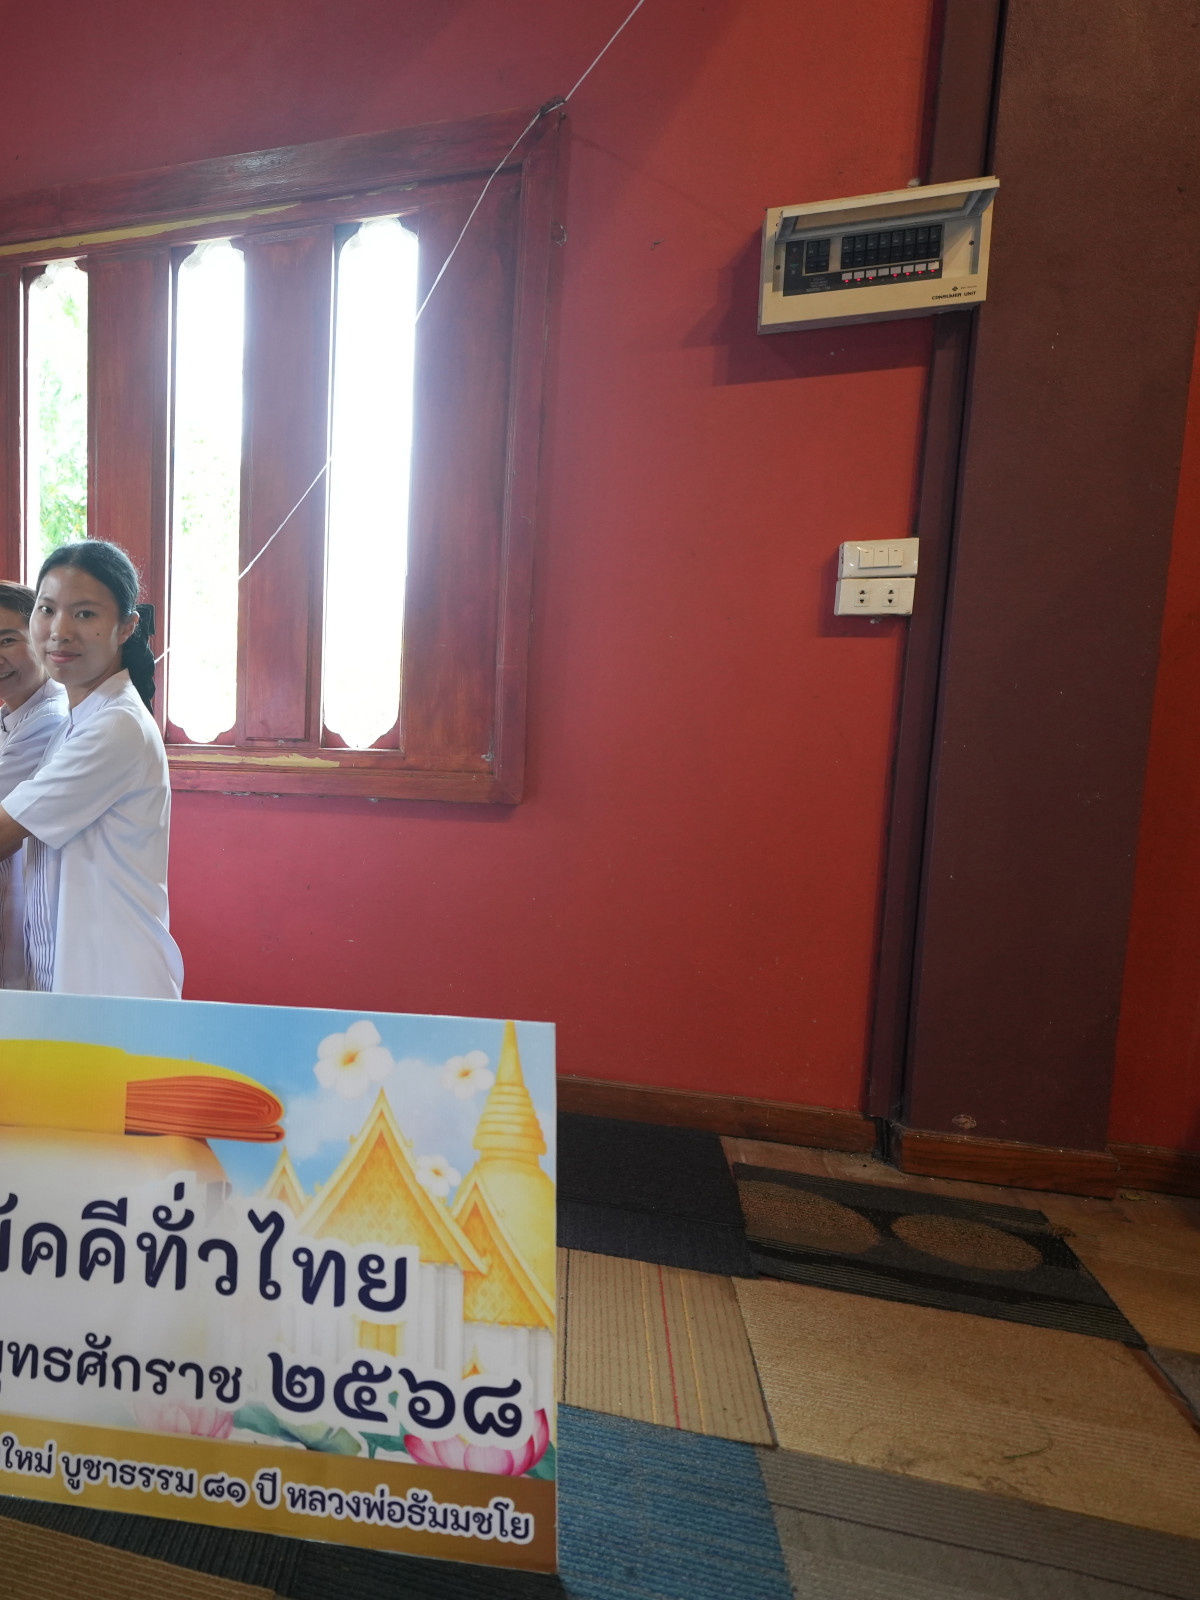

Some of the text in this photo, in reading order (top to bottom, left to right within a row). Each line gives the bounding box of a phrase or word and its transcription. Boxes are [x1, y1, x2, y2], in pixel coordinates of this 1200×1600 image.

[267, 1352, 523, 1438] ๒๕๖๘
[61, 1453, 194, 1495] บูชาธรรม
[203, 1475, 247, 1503] ๘๑
[255, 1471, 278, 1506] ปี
[287, 1484, 531, 1541] หลวงพ่อธัมมชโย
